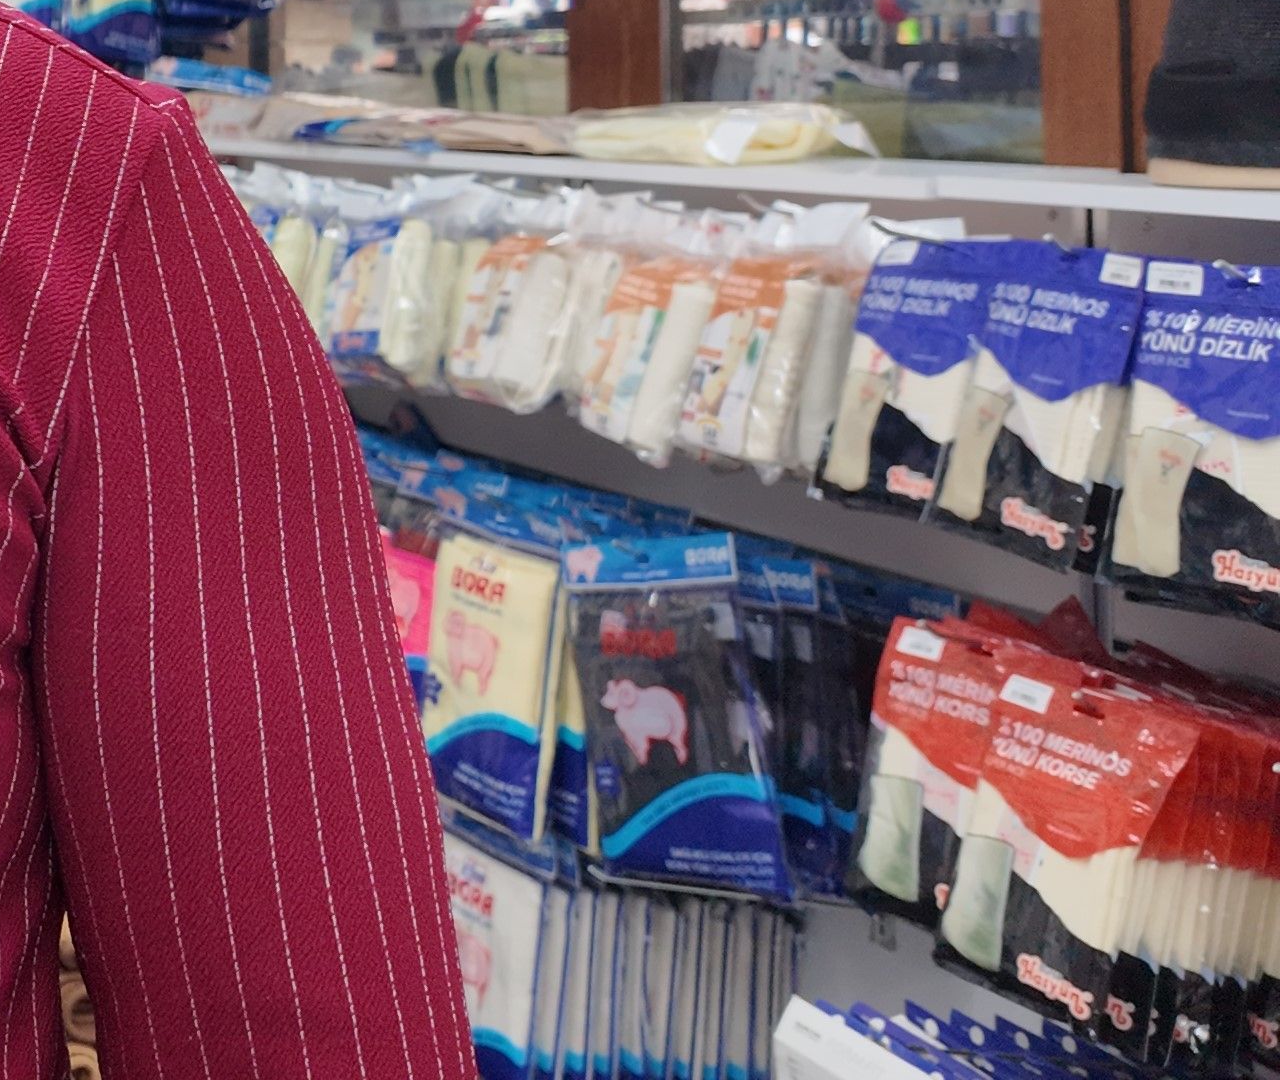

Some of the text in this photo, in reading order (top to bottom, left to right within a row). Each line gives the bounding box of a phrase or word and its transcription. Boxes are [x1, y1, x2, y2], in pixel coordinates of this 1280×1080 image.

[1031, 288, 1110, 318] MERİNOS
[1026, 308, 1078, 335] DİZLİK
[1145, 309, 1202, 333] %100
[1198, 334, 1274, 362] DİZLİK
[685, 547, 730, 566] BORA
[1215, 553, 1279, 587] Hasyü
[452, 568, 506, 602] BORA
[935, 673, 996, 705] MERİN
[934, 695, 990, 727] KORS
[1042, 732, 1132, 777] MERİNOS
[1035, 753, 1102, 790] KORSE
